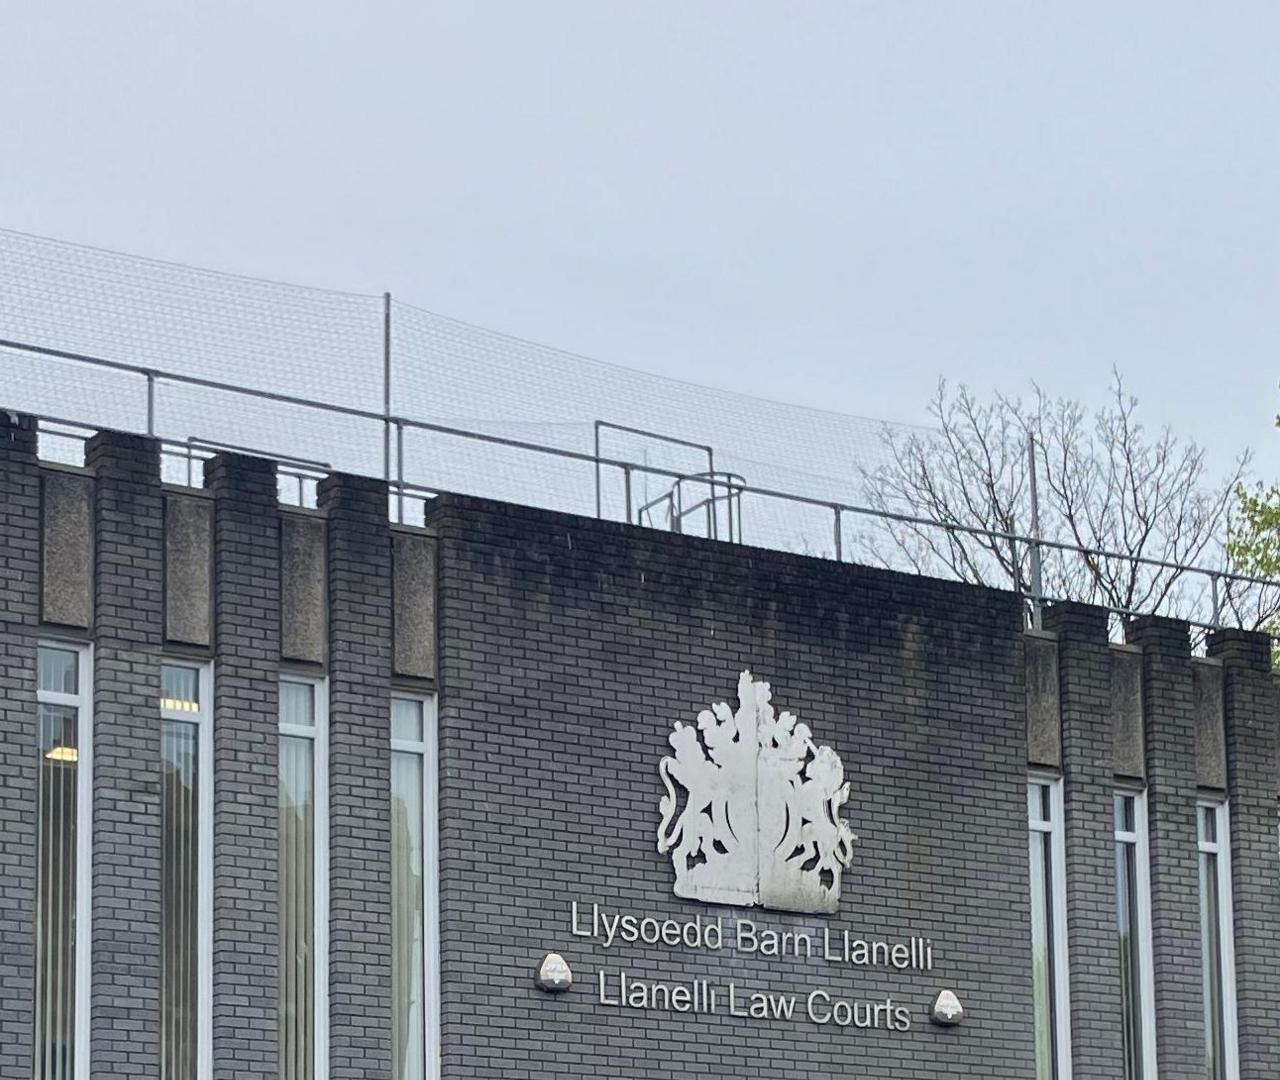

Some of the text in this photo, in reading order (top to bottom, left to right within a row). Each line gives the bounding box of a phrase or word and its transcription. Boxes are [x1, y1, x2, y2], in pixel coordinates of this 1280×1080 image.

[570, 901, 933, 970] Llysoedd Barn Llanelli
[599, 970, 911, 1032] Llanelli Law Courts
